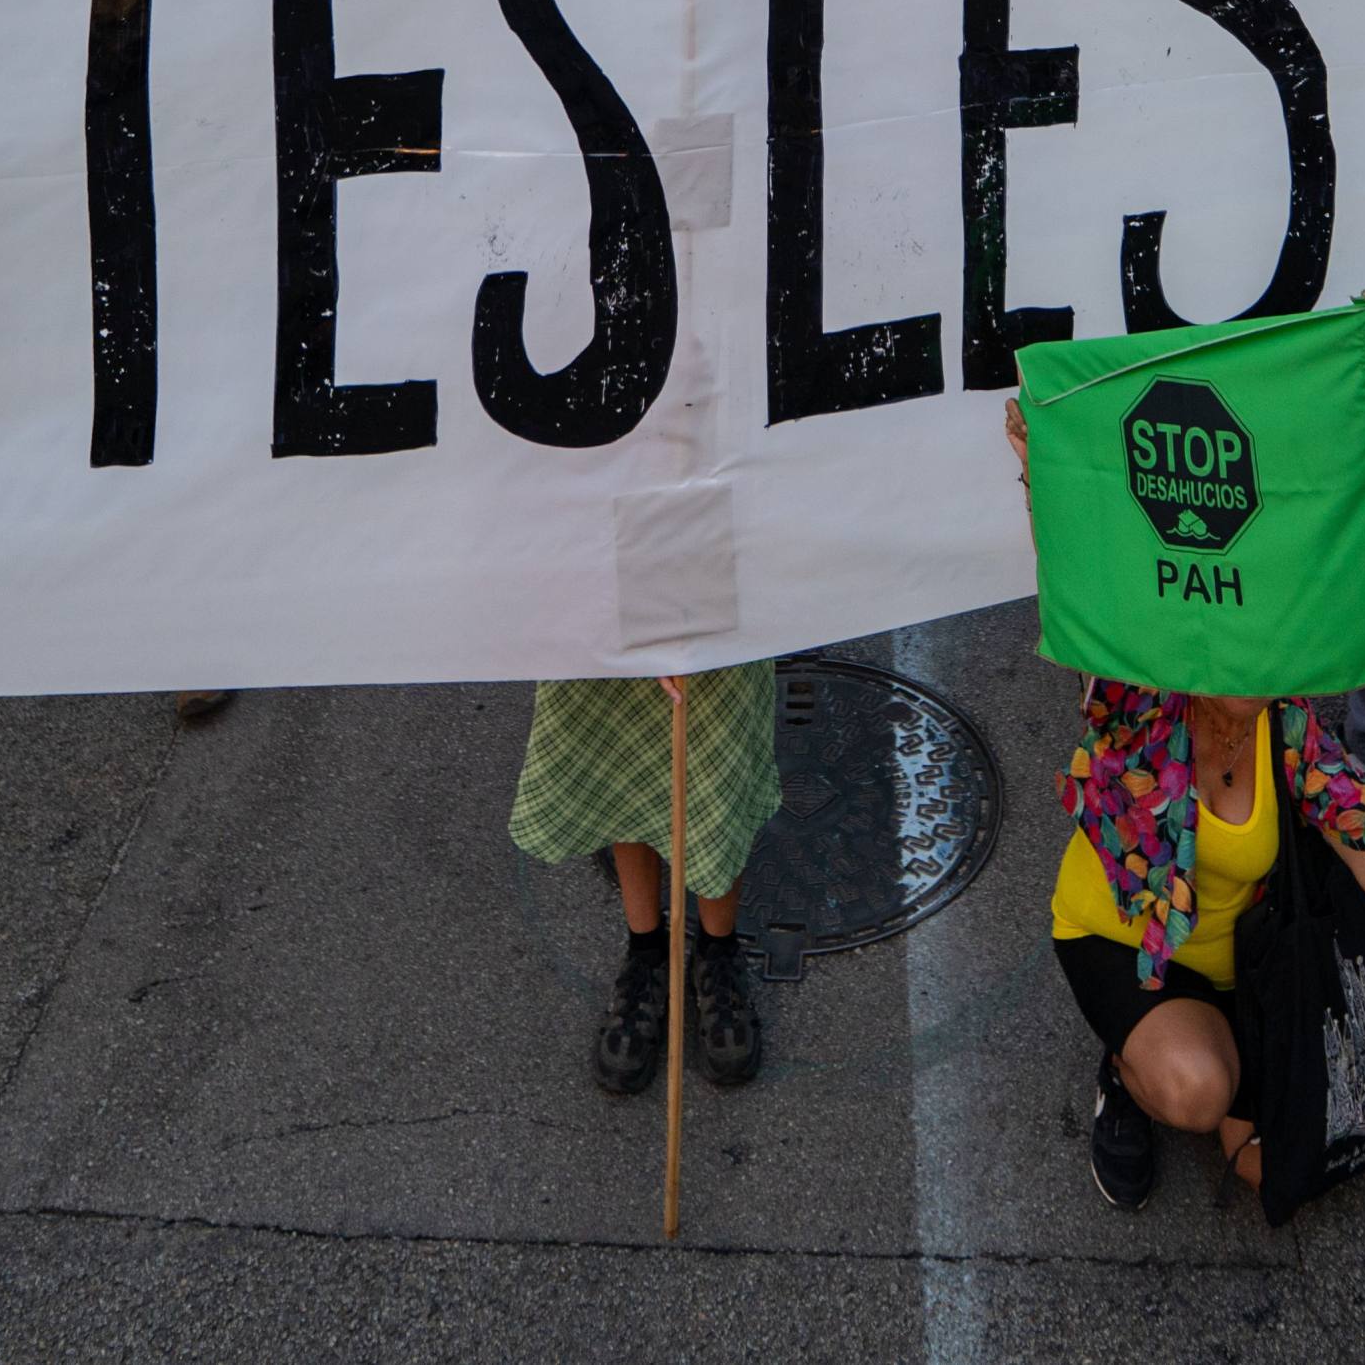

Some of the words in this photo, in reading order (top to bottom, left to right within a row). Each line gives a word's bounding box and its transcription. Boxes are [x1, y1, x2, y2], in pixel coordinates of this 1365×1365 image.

[1131, 418, 1243, 479] STOP
[1136, 472, 1248, 511] DESAHUCIOS
[1156, 558, 1244, 606] PAH
